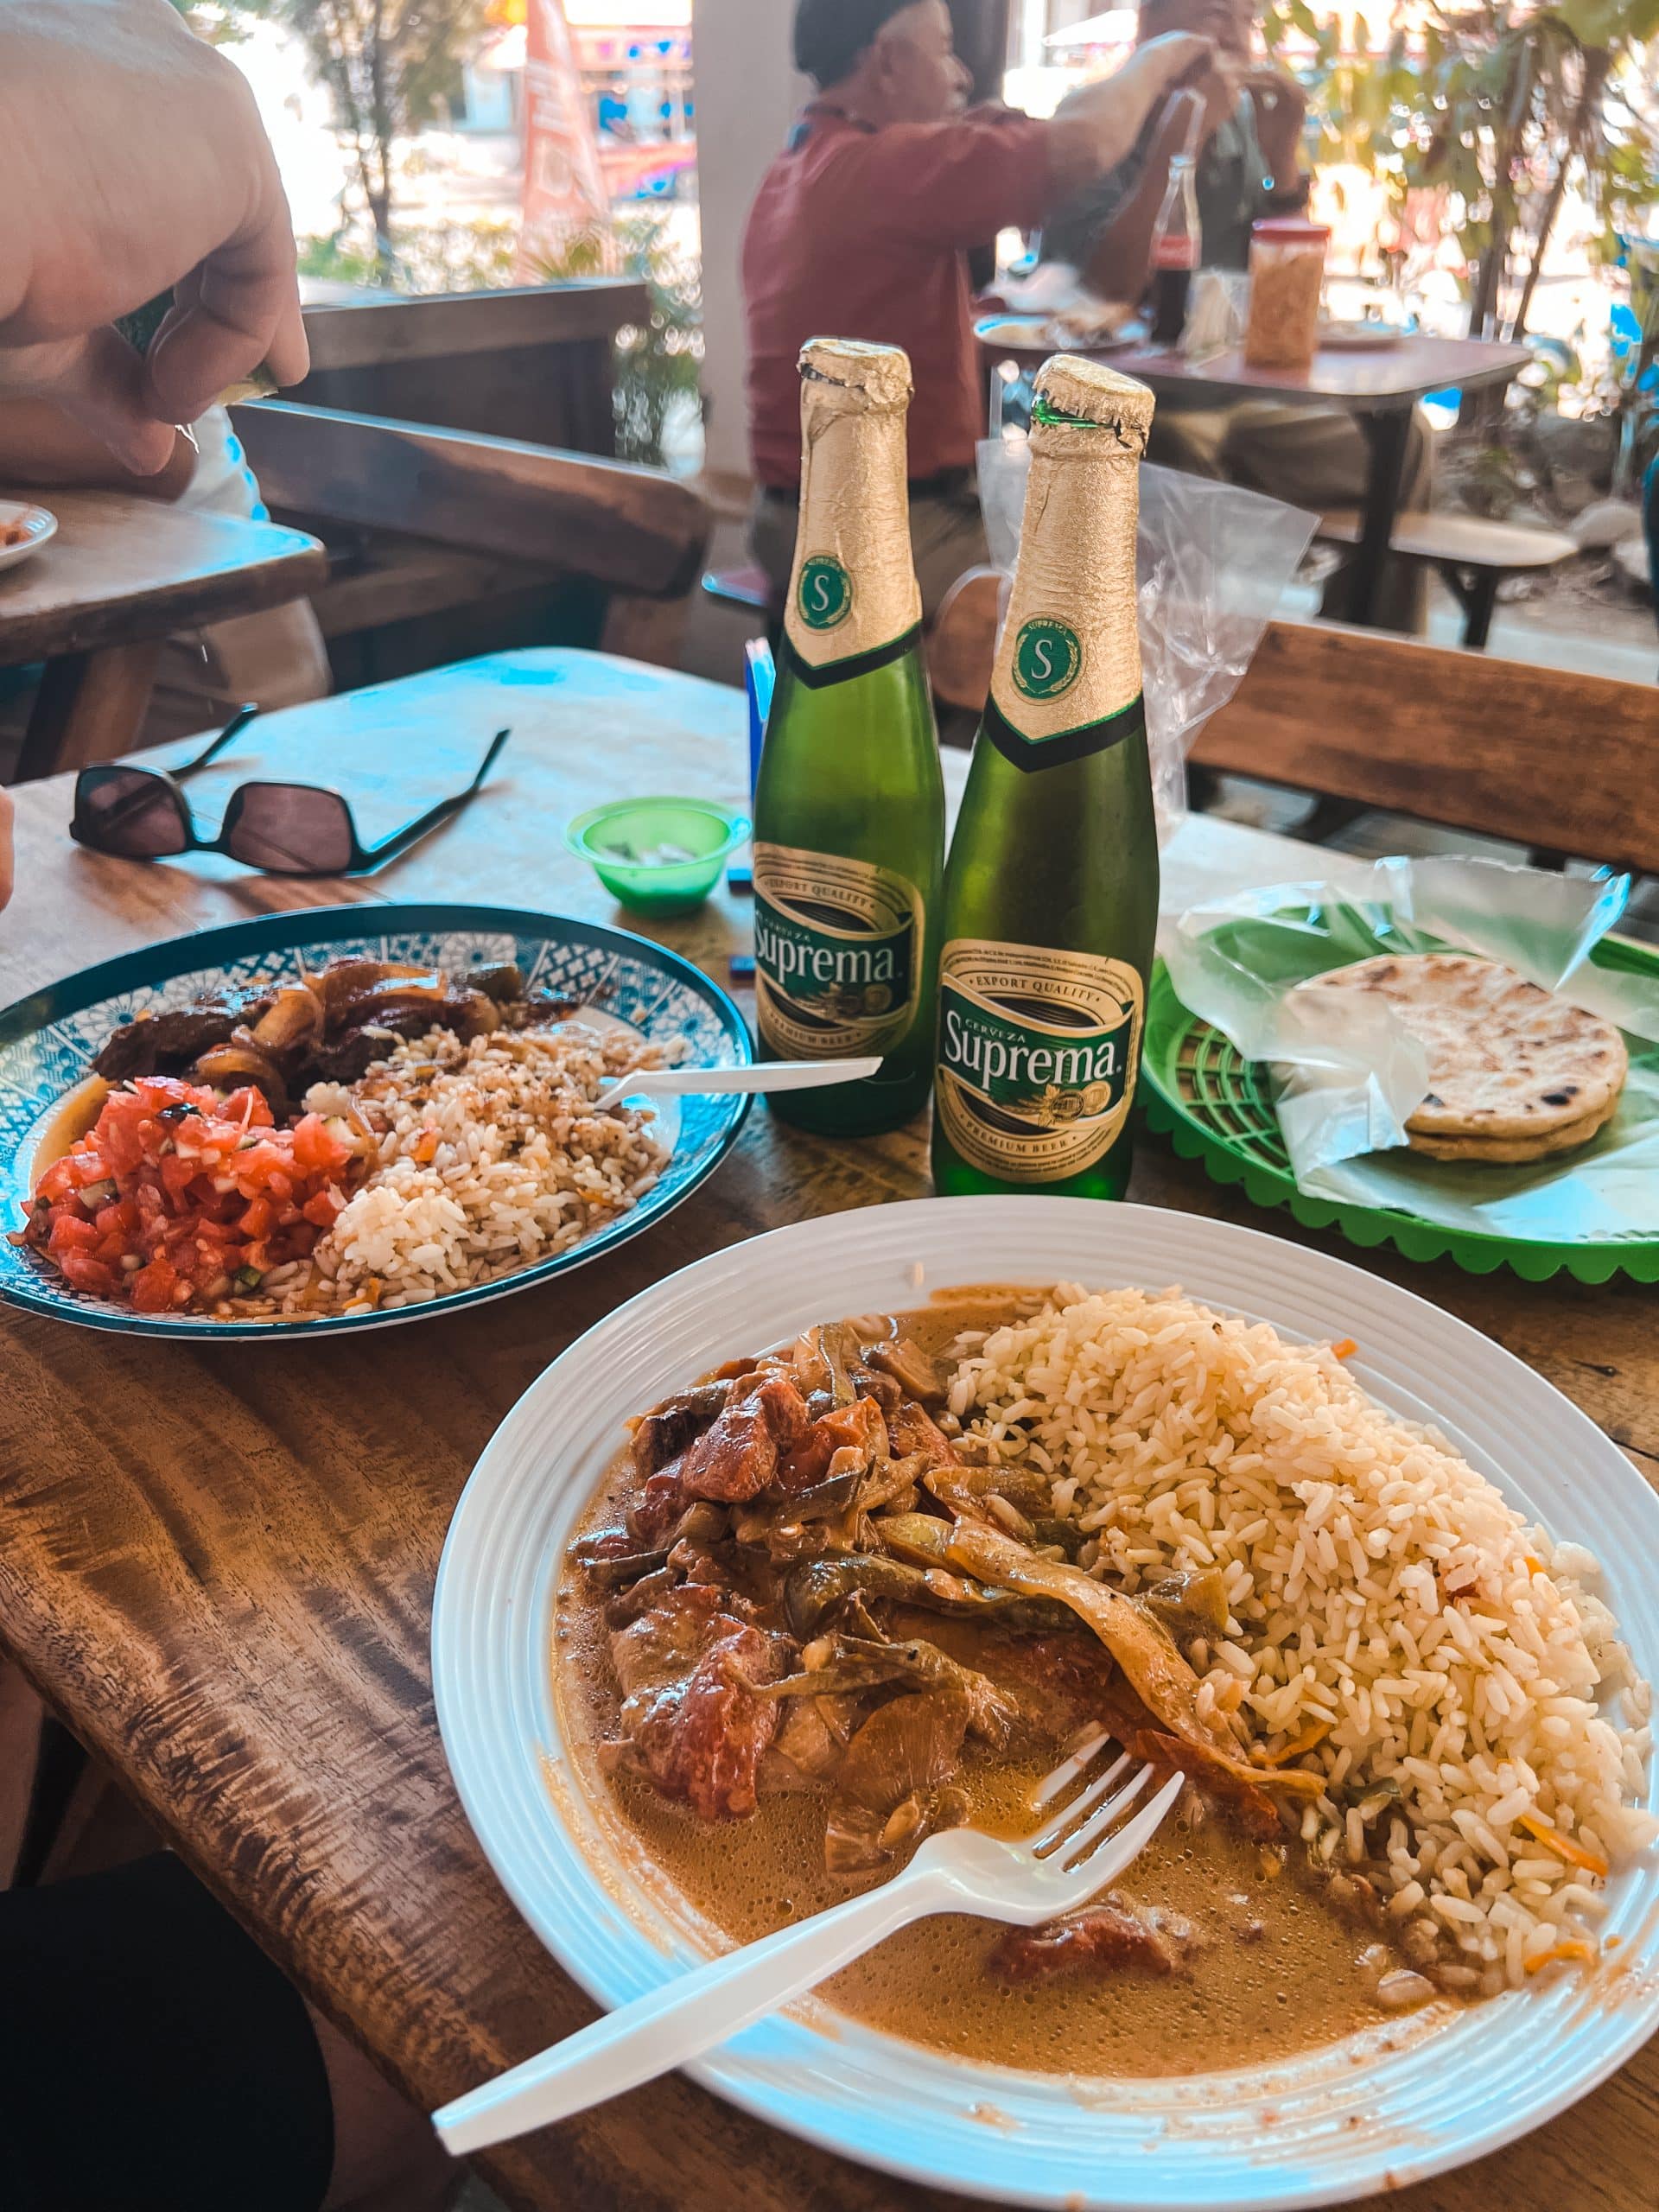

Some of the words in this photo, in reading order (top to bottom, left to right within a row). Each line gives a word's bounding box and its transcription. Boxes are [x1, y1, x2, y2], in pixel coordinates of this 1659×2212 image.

[810, 575, 830, 612] S
[1031, 639, 1052, 680] S
[976, 976, 1028, 989] EXPORT
[1033, 981, 1095, 1002] QUALITY
[965, 1019, 1027, 1044] CERVEZA
[966, 1122, 1027, 1154] PREMIUM
[1032, 1140, 1068, 1154] BEER
